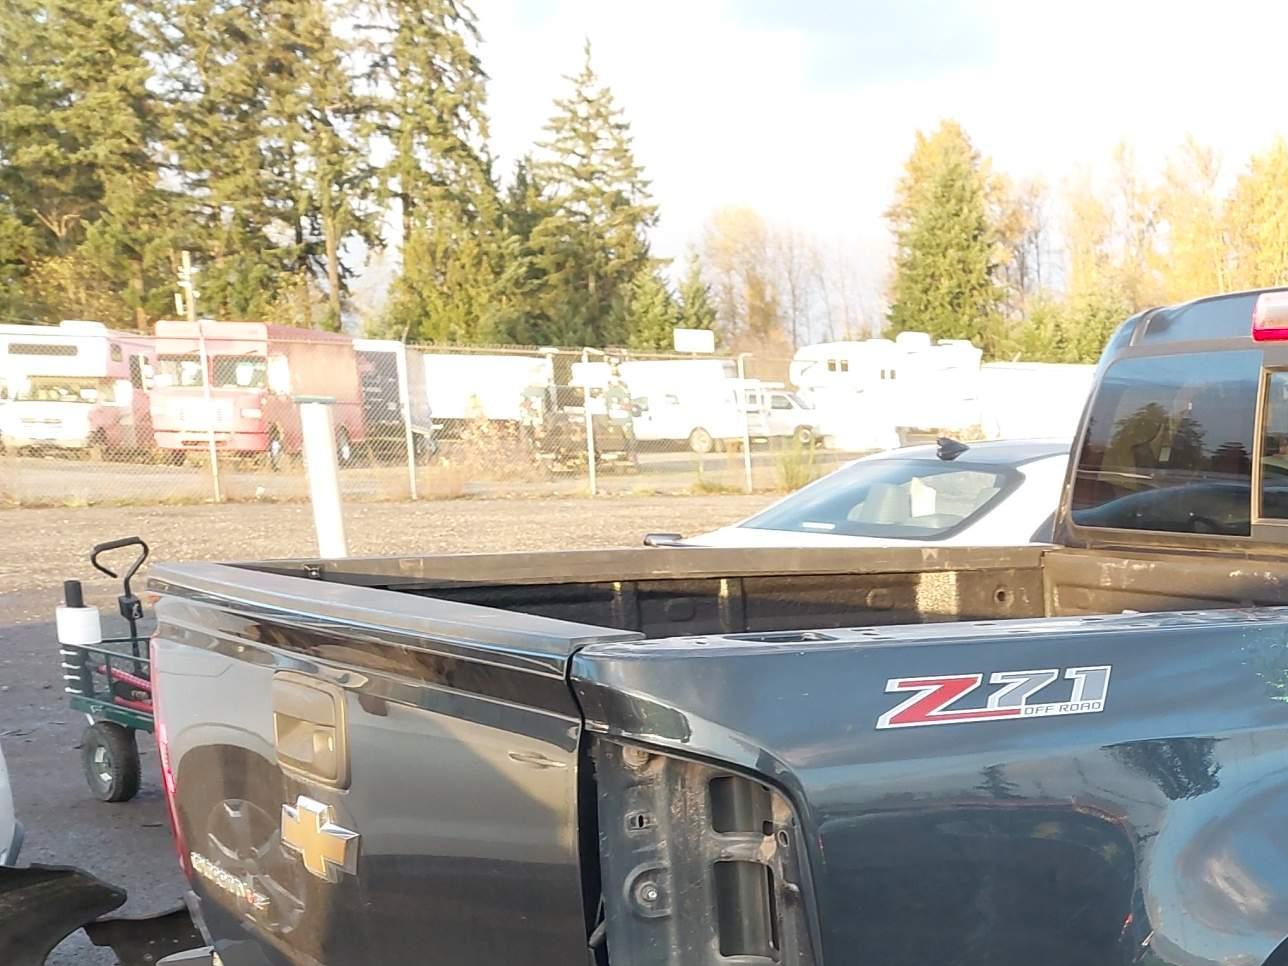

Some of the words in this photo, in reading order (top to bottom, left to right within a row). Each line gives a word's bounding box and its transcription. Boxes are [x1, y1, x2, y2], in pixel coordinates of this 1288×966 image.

[876, 665, 1112, 729] Z71
[1024, 705, 1056, 715] OFF
[1059, 701, 1102, 712] ROAD
